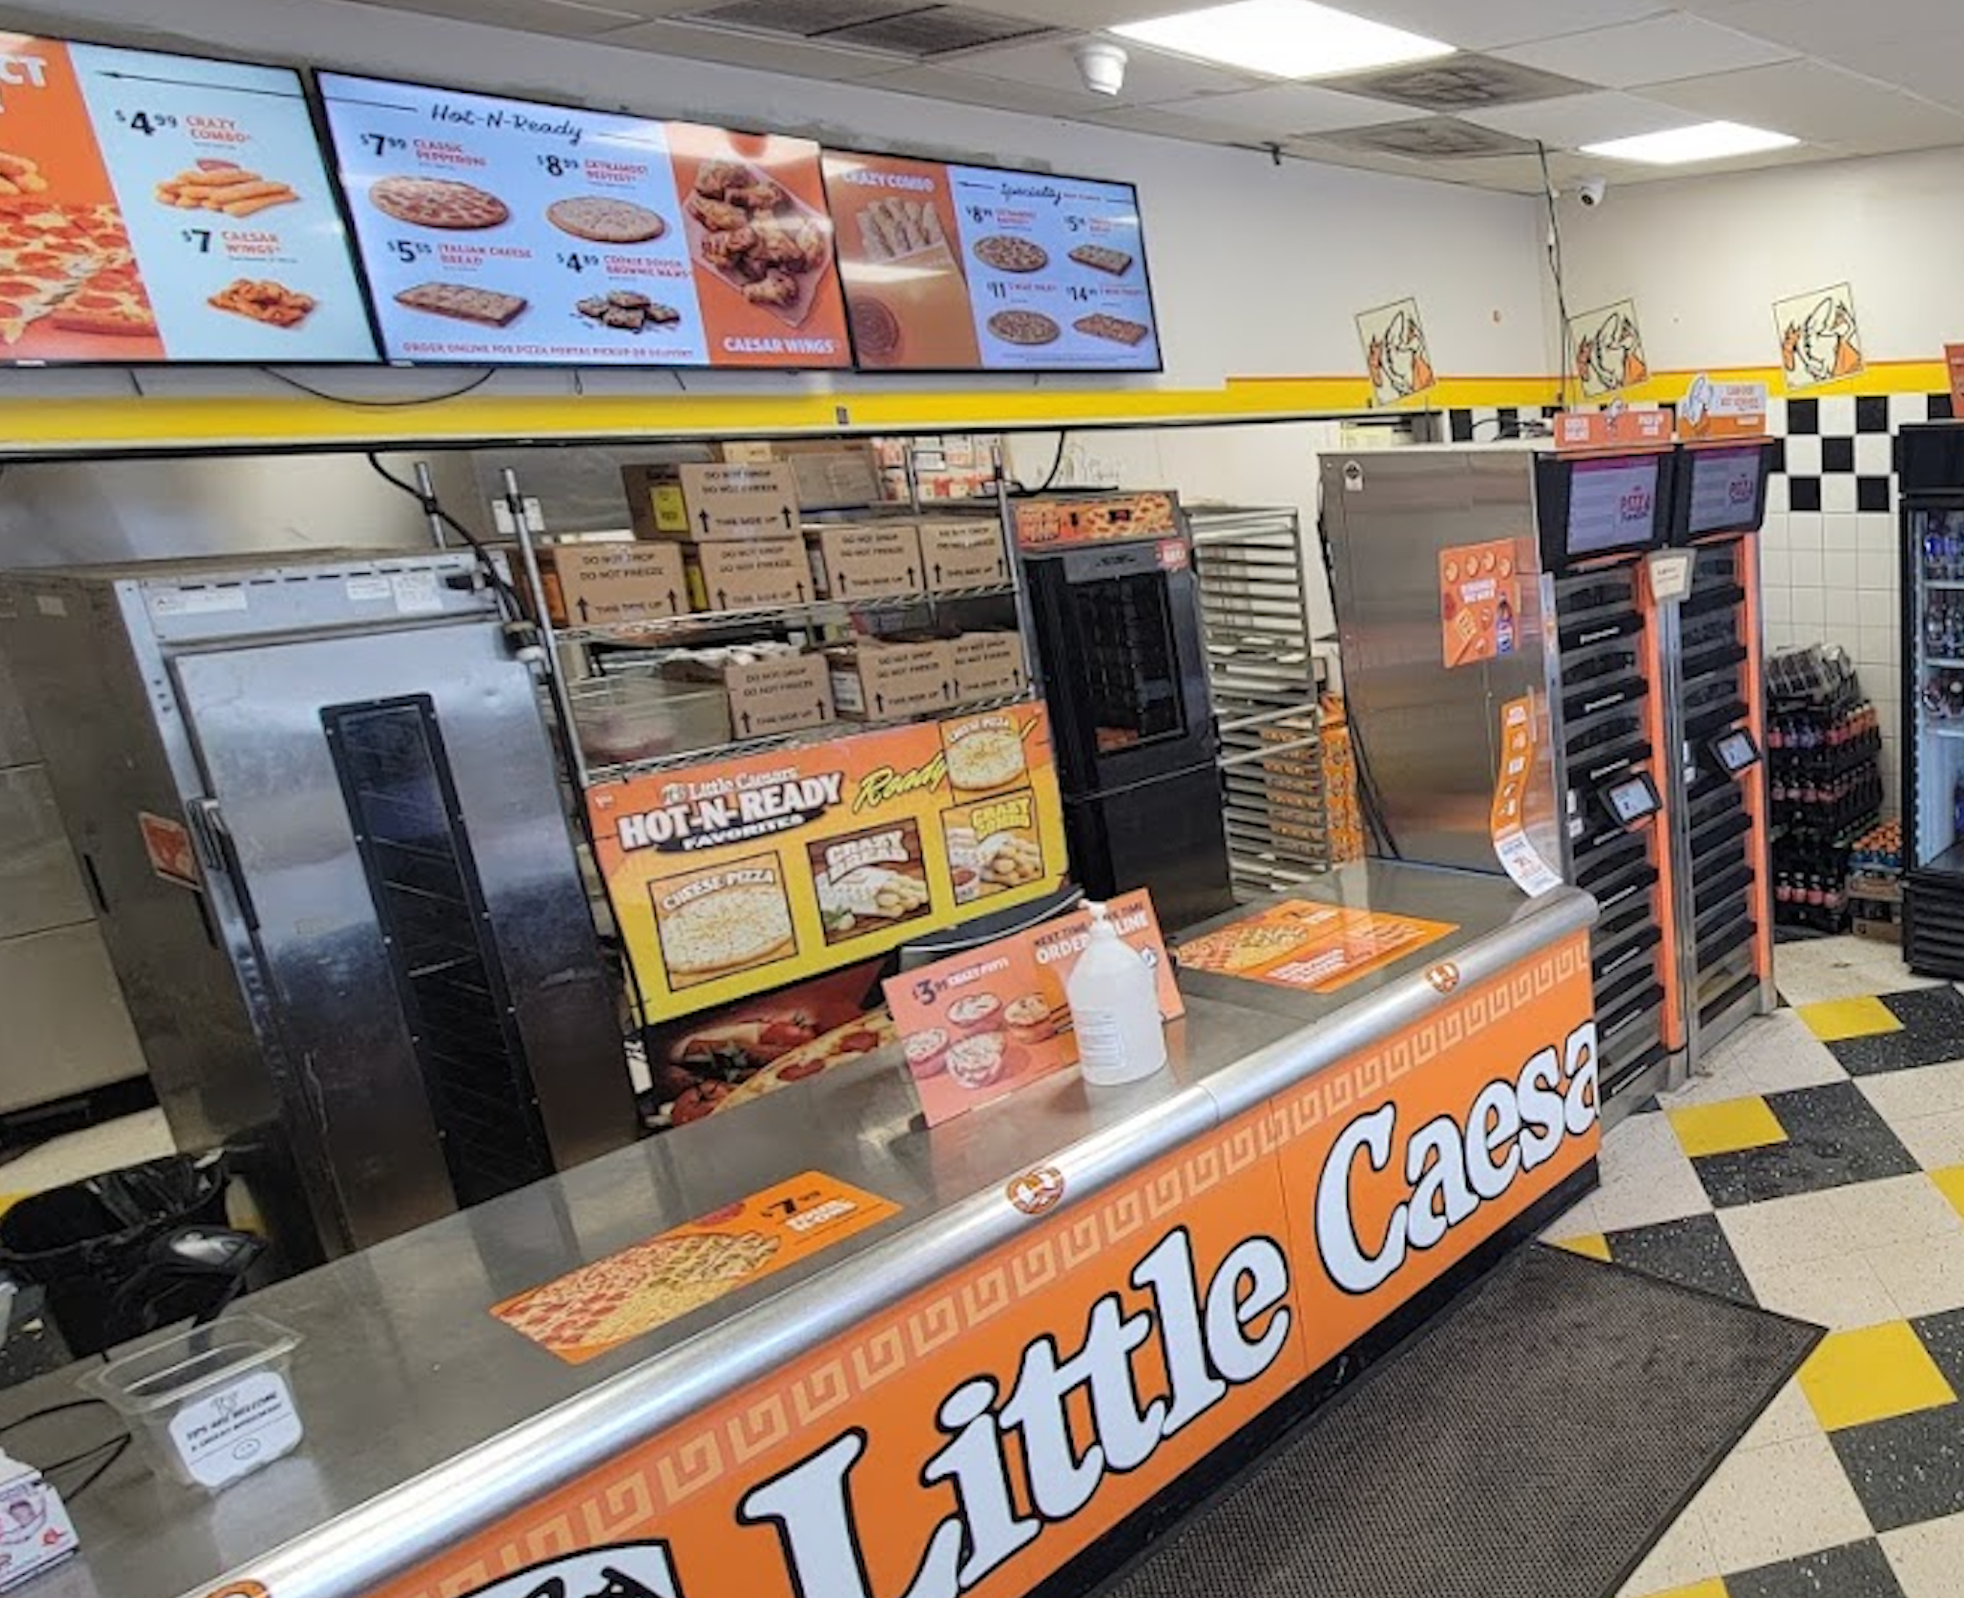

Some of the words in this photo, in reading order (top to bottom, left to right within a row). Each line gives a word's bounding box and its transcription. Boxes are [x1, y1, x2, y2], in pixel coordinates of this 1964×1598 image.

[186, 114, 237, 131] CRAZY
[431, 104, 583, 146] Hot-N-Ready
[723, 336, 786, 352] CAESAR
[786, 339, 834, 354] WINGS
[687, 776, 734, 799] Little
[616, 771, 844, 852] HOT-N-READY
[738, 1224, 1291, 1598] Little
